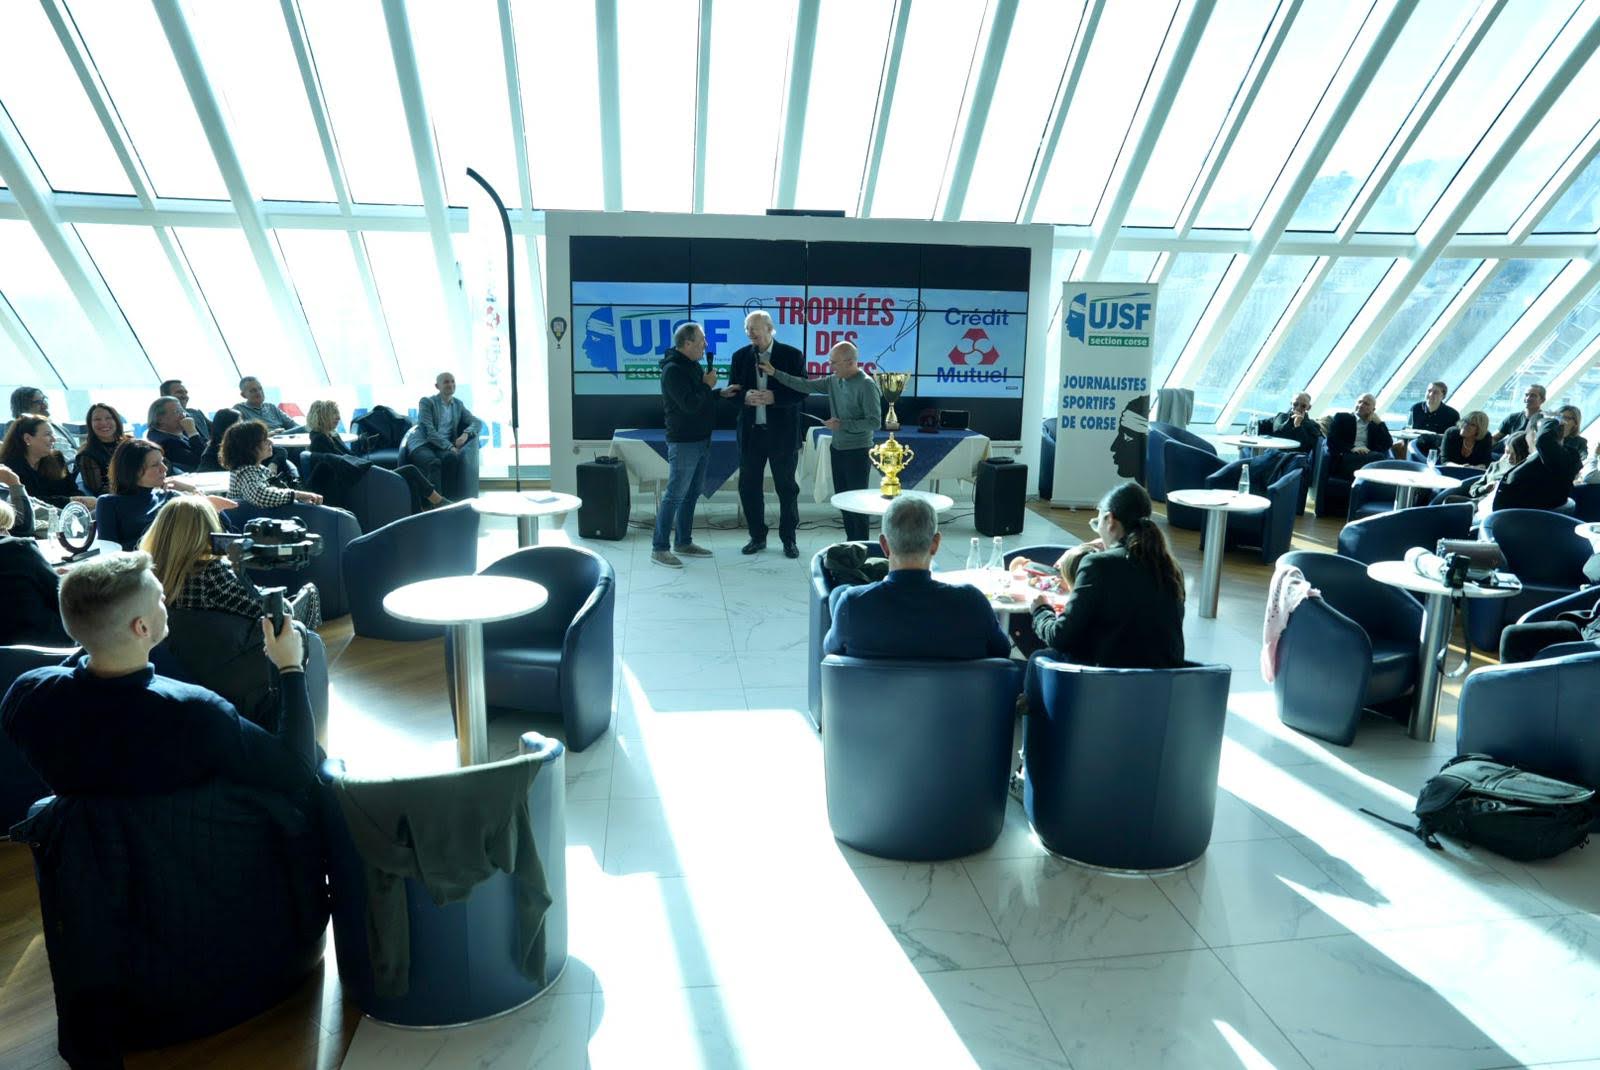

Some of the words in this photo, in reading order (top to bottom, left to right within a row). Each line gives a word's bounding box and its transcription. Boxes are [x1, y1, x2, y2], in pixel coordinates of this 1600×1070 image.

[775, 293, 895, 327] TROPHÉES
[944, 307, 1009, 326] Crédit
[1088, 302, 1152, 331] UJSF
[620, 319, 730, 356] UJF
[1090, 336, 1122, 346] section
[1123, 338, 1148, 347] corse
[936, 366, 1008, 384] Mutuel
[1063, 375, 1147, 391] JOURNALISTES
[1062, 395, 1116, 411] SPORTIFS
[1061, 415, 1076, 429] DE
[1080, 416, 1116, 431] CORSE
